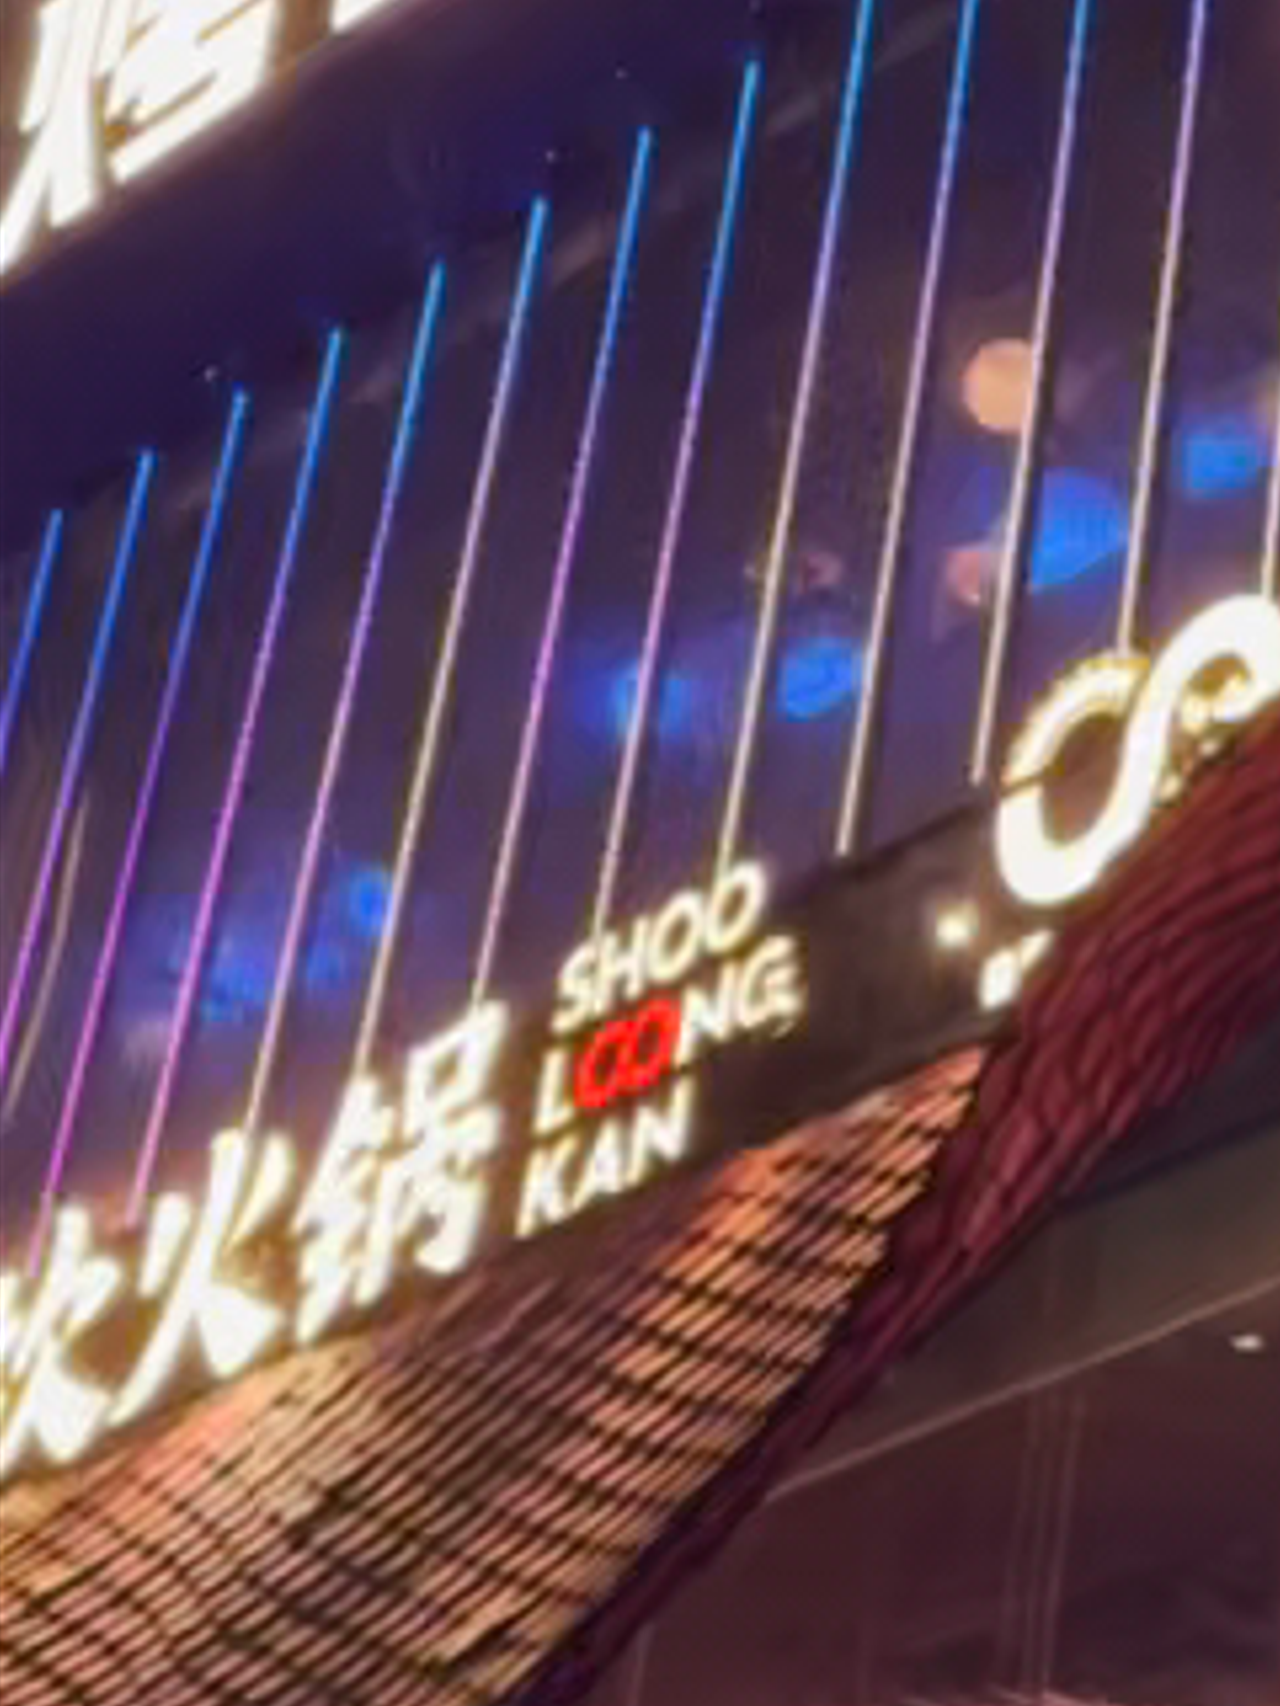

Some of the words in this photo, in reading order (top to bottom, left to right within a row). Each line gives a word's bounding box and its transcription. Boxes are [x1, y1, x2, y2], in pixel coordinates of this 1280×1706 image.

[533, 934, 801, 1133] LOONG
[548, 859, 770, 1034] SHOO
[516, 1078, 697, 1240] KAN
